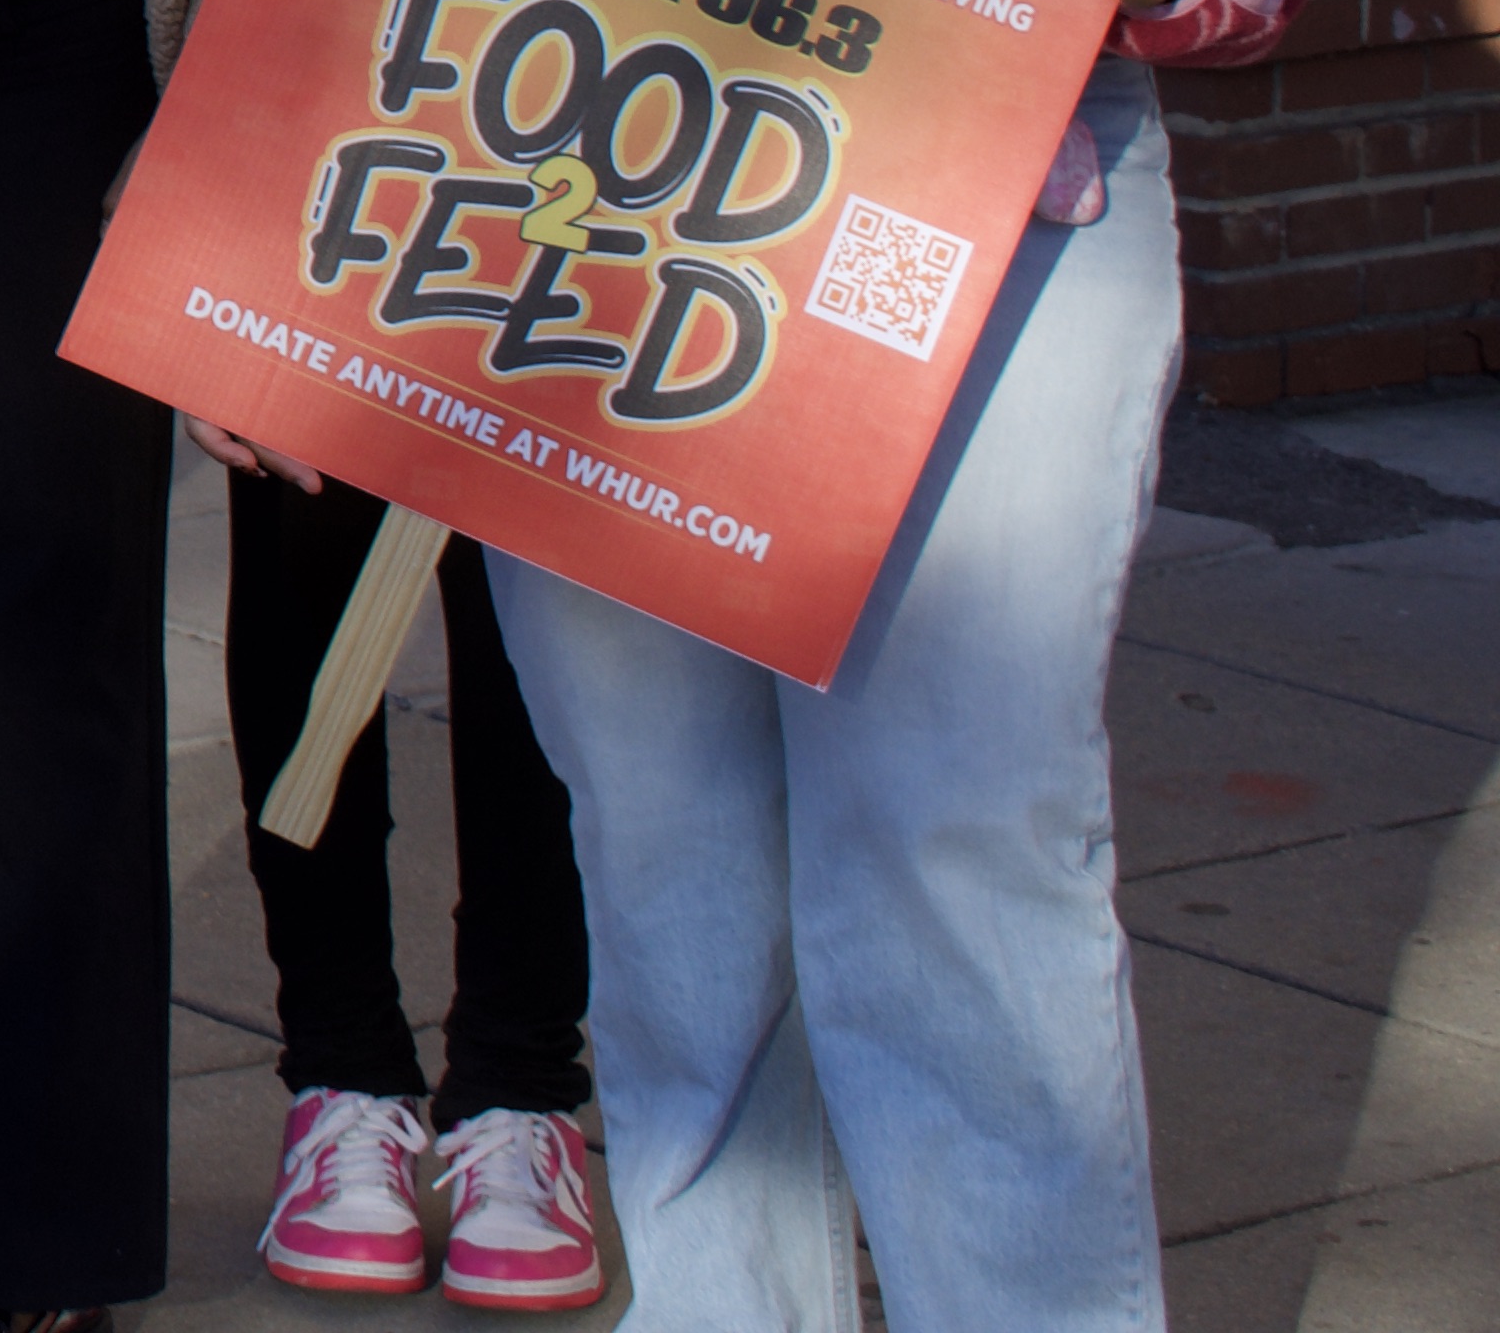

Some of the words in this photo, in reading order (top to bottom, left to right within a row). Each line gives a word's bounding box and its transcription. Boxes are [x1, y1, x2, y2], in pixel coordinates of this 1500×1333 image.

[305, 137, 768, 426] FEED
[183, 285, 336, 373] DONATE
[335, 354, 504, 446] ANYTIME
[505, 428, 559, 467] AT
[565, 448, 771, 562] WHUR.COM
